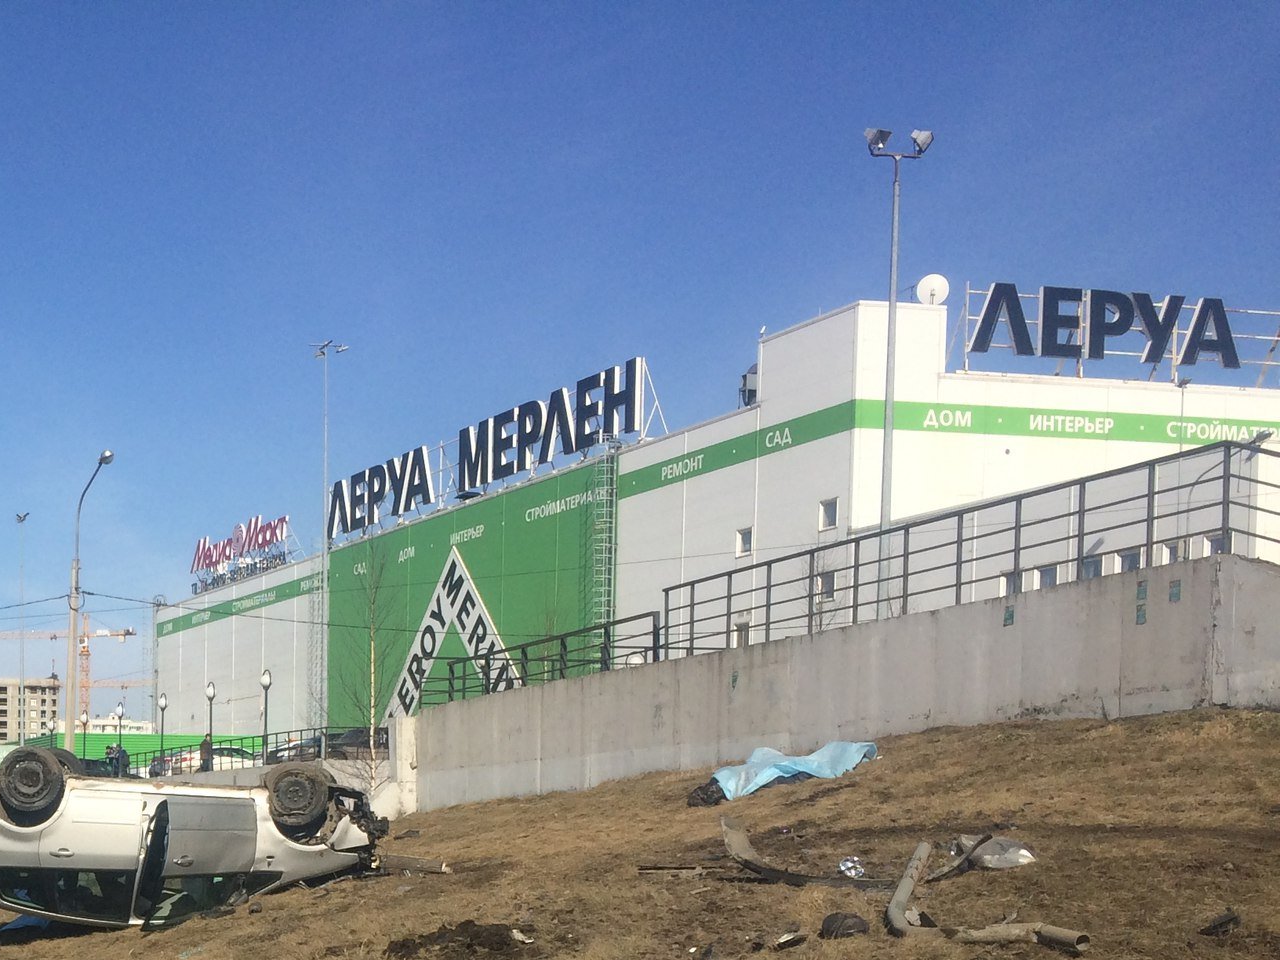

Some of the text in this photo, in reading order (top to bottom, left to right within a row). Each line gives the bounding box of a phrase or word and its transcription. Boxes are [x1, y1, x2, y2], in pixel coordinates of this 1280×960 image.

[969, 282, 1241, 369] ЛЕРУА
[327, 357, 643, 539] ЛЕРУА МЕРЛЕН
[661, 427, 792, 481] РЕМОНТ САД
[923, 408, 973, 429] ДОМ
[1029, 413, 1115, 435] ИНТЕРЬЕР
[353, 562, 367, 576] САД
[398, 545, 415, 563] ДОМ
[450, 524, 485, 546] ИНТЕРЬЕР
[388, 593, 446, 718] EROY
